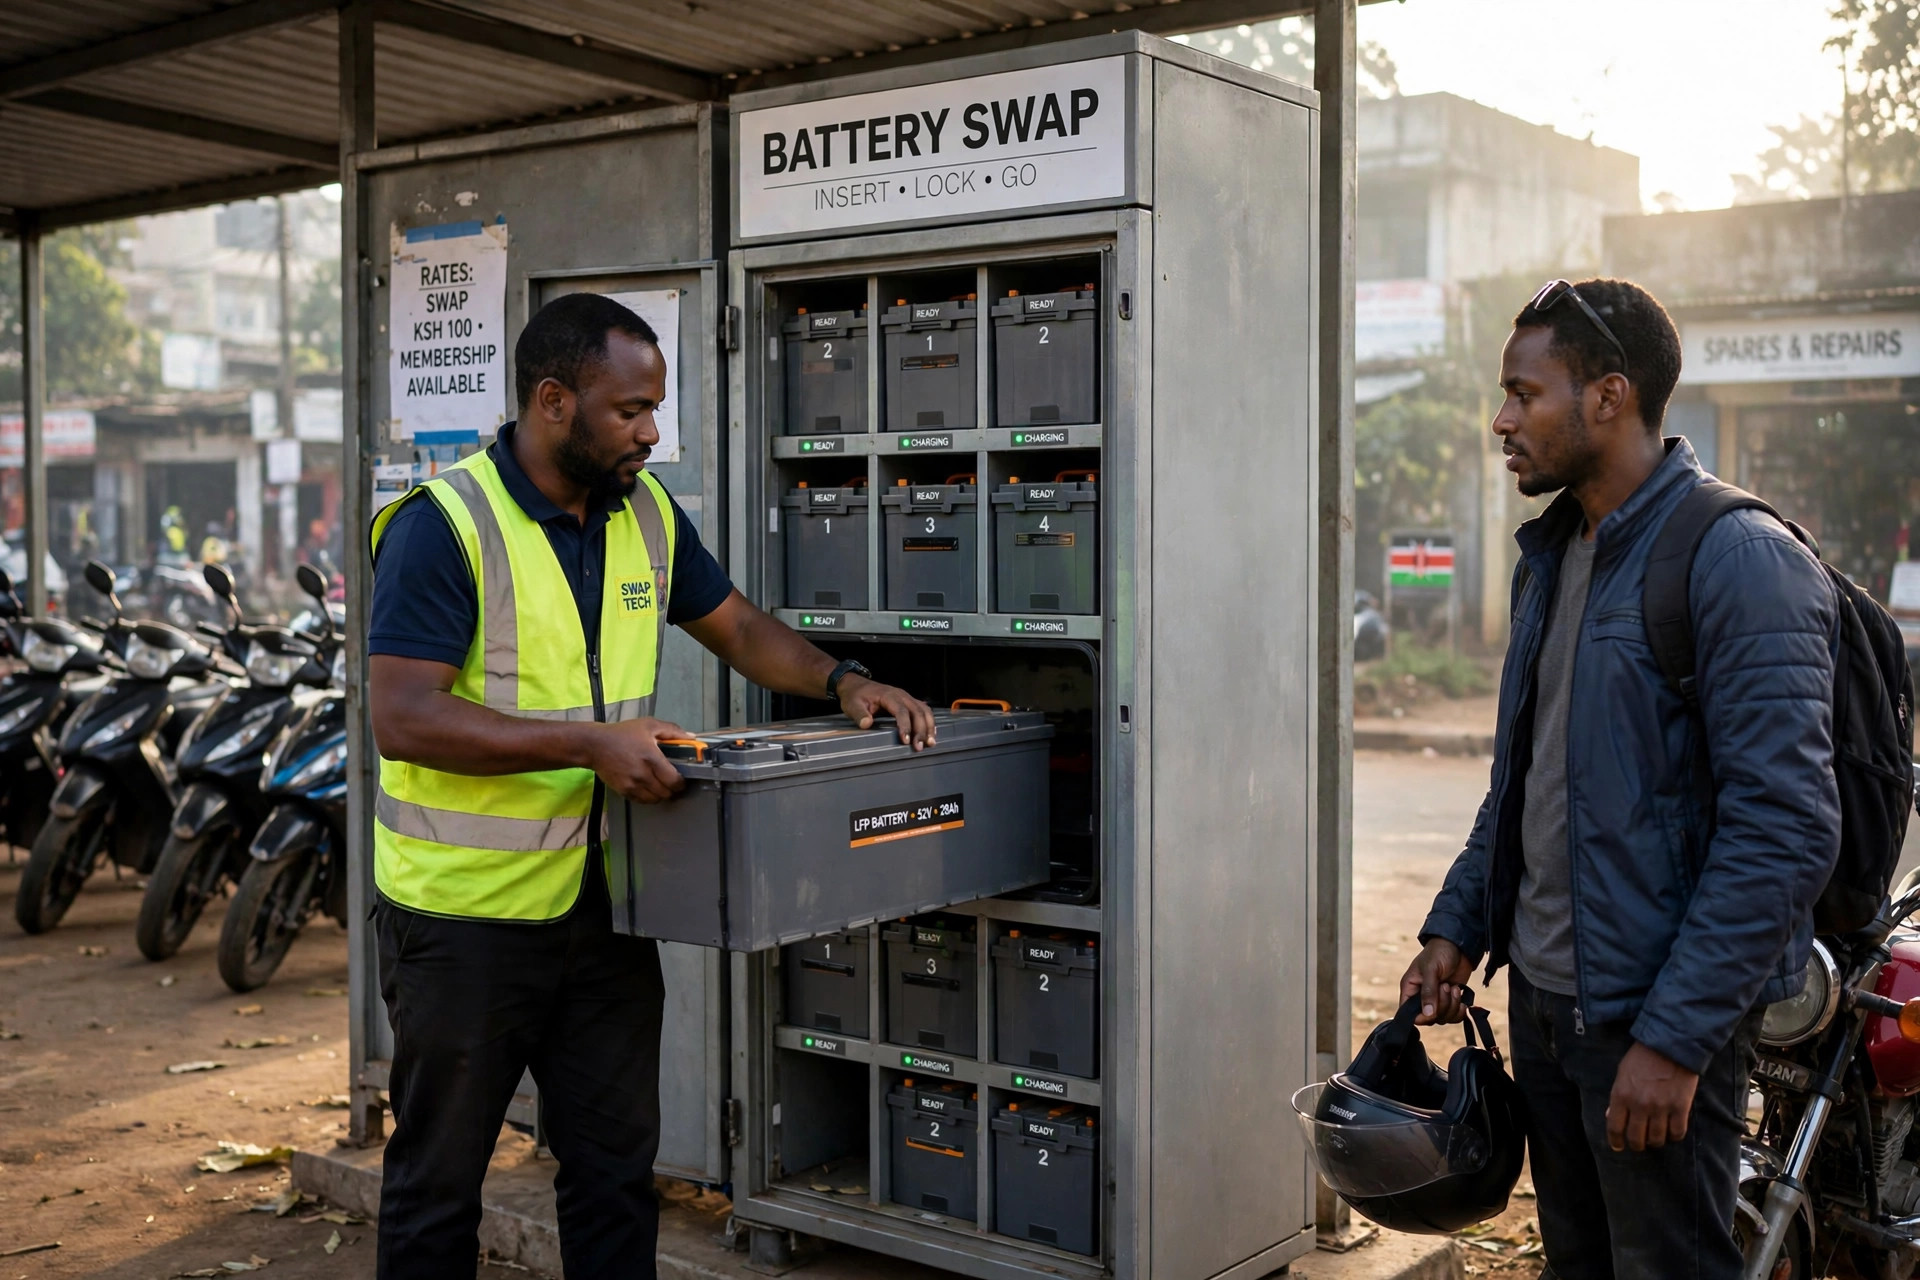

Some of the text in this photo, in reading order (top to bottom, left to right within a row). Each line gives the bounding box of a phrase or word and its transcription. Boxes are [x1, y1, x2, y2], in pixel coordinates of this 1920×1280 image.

[763, 87, 1099, 176] BATTERY SWAP
[814, 181, 890, 210] INSERT
[915, 170, 976, 199] LOCK
[1001, 163, 1037, 189] GO
[420, 262, 473, 286] RATES:
[426, 290, 469, 313] SWAP
[1029, 299, 1055, 310] READY
[916, 308, 940, 318] READY
[814, 316, 837, 327] READY
[413, 321, 443, 341] KSH
[447, 319, 472, 338] 100
[1038, 326, 1049, 344] 2
[823, 342, 833, 359] 2
[926, 335, 933, 351] 1
[1704, 329, 1903, 364] SPARES & REPAIRS
[400, 344, 497, 369] MEMBERSHIP
[406, 373, 486, 397] AVAILABLE
[911, 437, 949, 447] CHARGING
[1024, 433, 1065, 444] CHARGING
[916, 491, 940, 501] READY
[1029, 489, 1055, 499] READY
[823, 518, 831, 534] 1
[925, 517, 935, 534] 3
[1038, 515, 1050, 533] 4
[621, 581, 651, 596] SWAP
[623, 595, 651, 611] TECH
[911, 619, 949, 630] CHARGING
[1024, 622, 1064, 632] CHARGING
[854, 817, 871, 832] LFP
[871, 811, 909, 829] BATTERY
[917, 806, 933, 820] 52V
[939, 801, 959, 816] 28Ah
[824, 943, 831, 959] 1
[1029, 948, 1055, 960] READY
[926, 958, 937, 975] 3
[1039, 973, 1050, 992] 2
[912, 1057, 950, 1073] CHARGING
[1024, 1078, 1064, 1094] CHARGING
[921, 1098, 945, 1110] READY
[930, 1121, 940, 1138] 2
[1029, 1123, 1054, 1136] READY
[1038, 1149, 1049, 1167] 2
